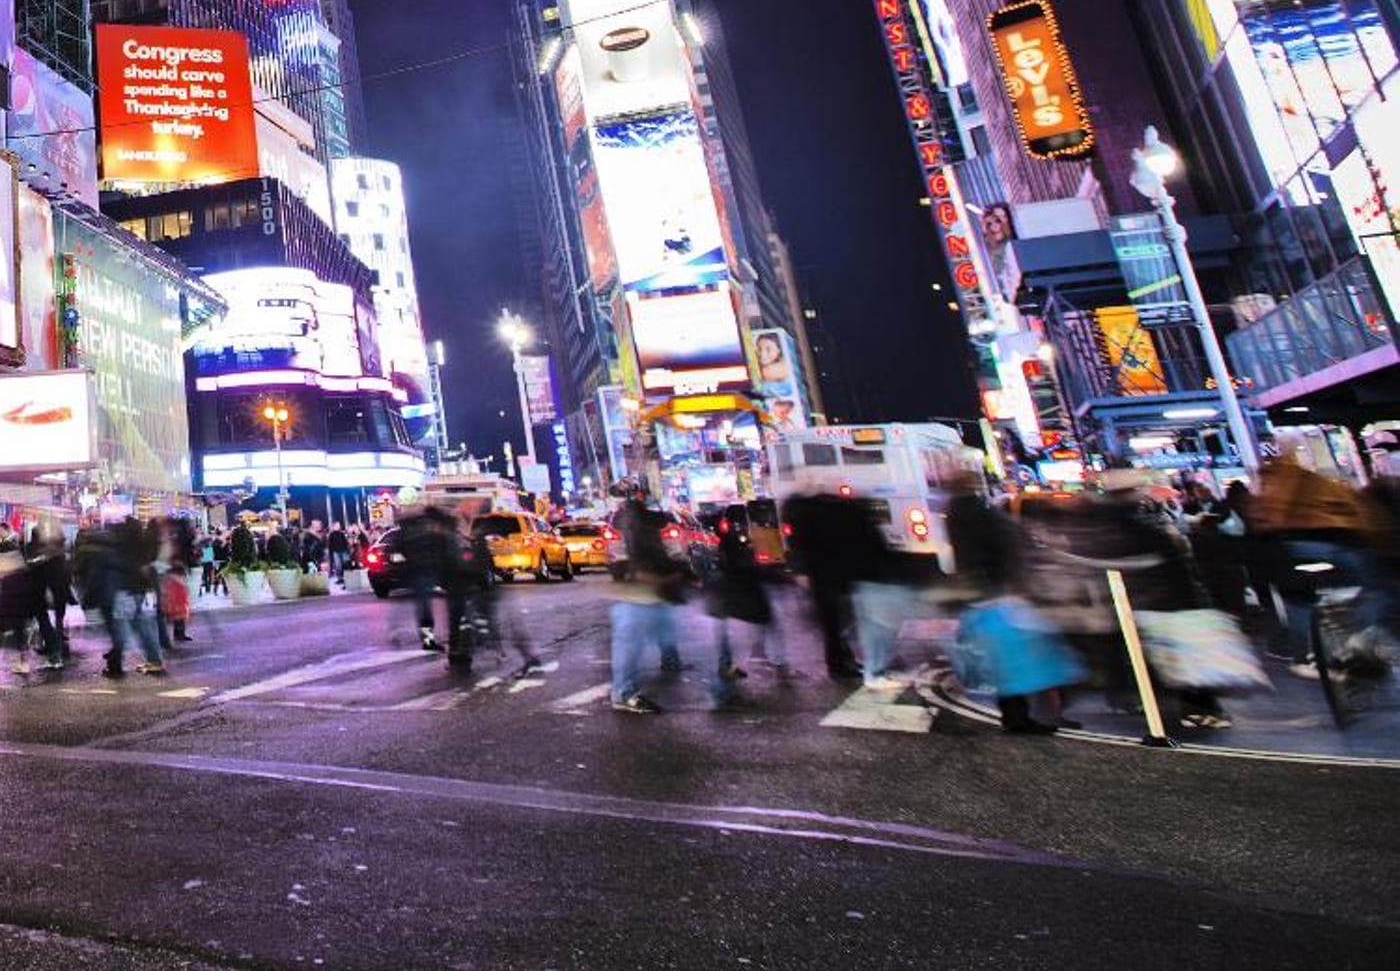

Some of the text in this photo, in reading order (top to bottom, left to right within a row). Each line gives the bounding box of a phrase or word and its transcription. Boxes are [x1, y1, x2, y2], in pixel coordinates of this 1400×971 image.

[122, 39, 224, 65] Congress
[123, 64, 224, 83] should carve
[123, 85, 227, 100] spending like a
[260, 179, 275, 235] 1500
[919, 143, 979, 287] YOUNG
